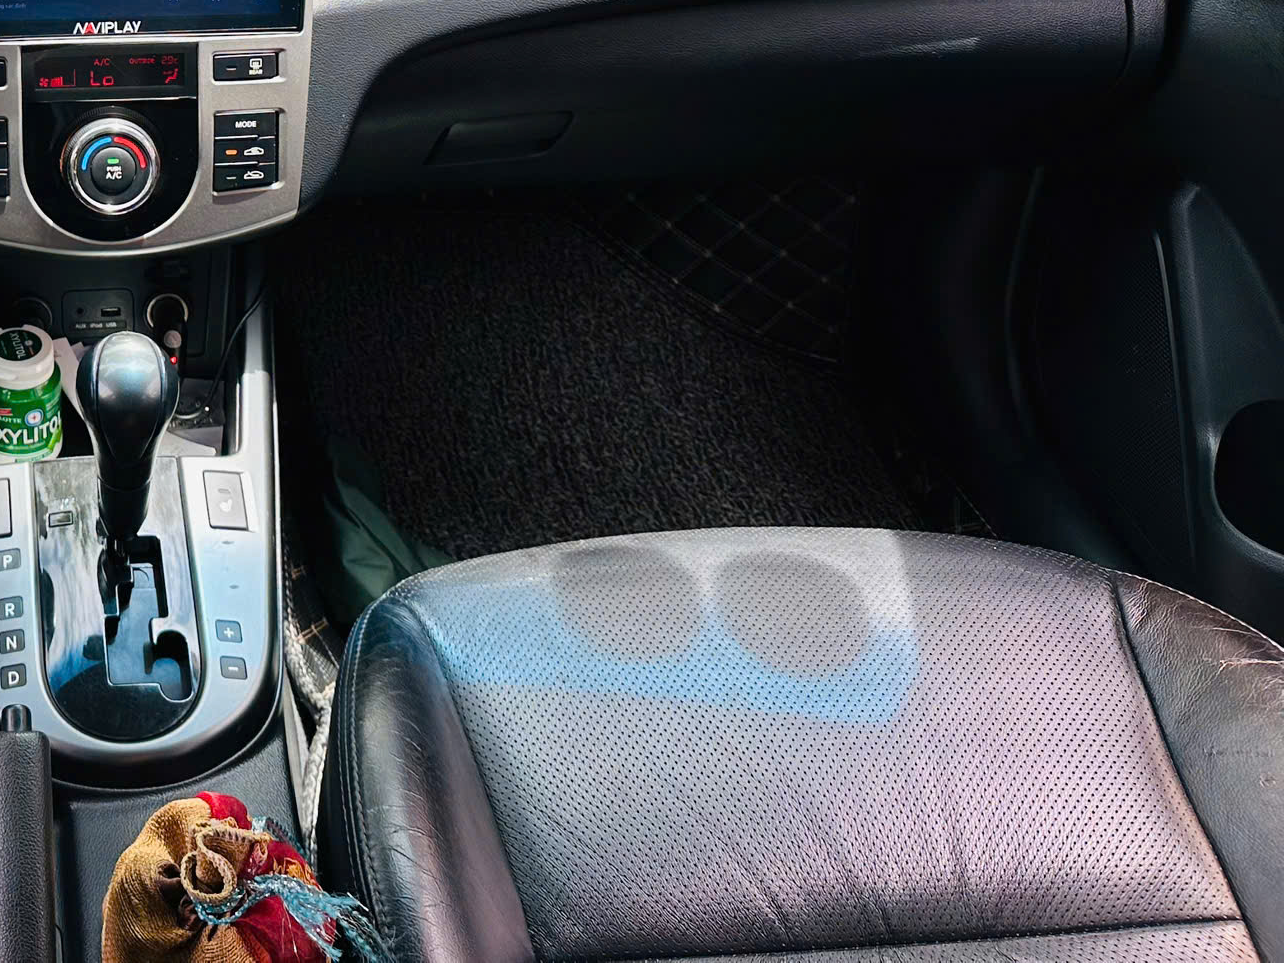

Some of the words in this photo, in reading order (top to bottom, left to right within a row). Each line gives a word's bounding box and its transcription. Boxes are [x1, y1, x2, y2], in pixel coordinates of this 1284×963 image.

[72, 20, 142, 35] NAVIPLAY
[93, 57, 111, 66] A/C
[235, 120, 257, 129] MODE
[106, 172, 123, 180] A/C
[9, 332, 26, 359] XYLITOL
[0, 415, 22, 424] LOTTE
[2, 554, 13, 569] P
[4, 602, 15, 618] R
[5, 635, 17, 651] N
[7, 671, 20, 686] D
